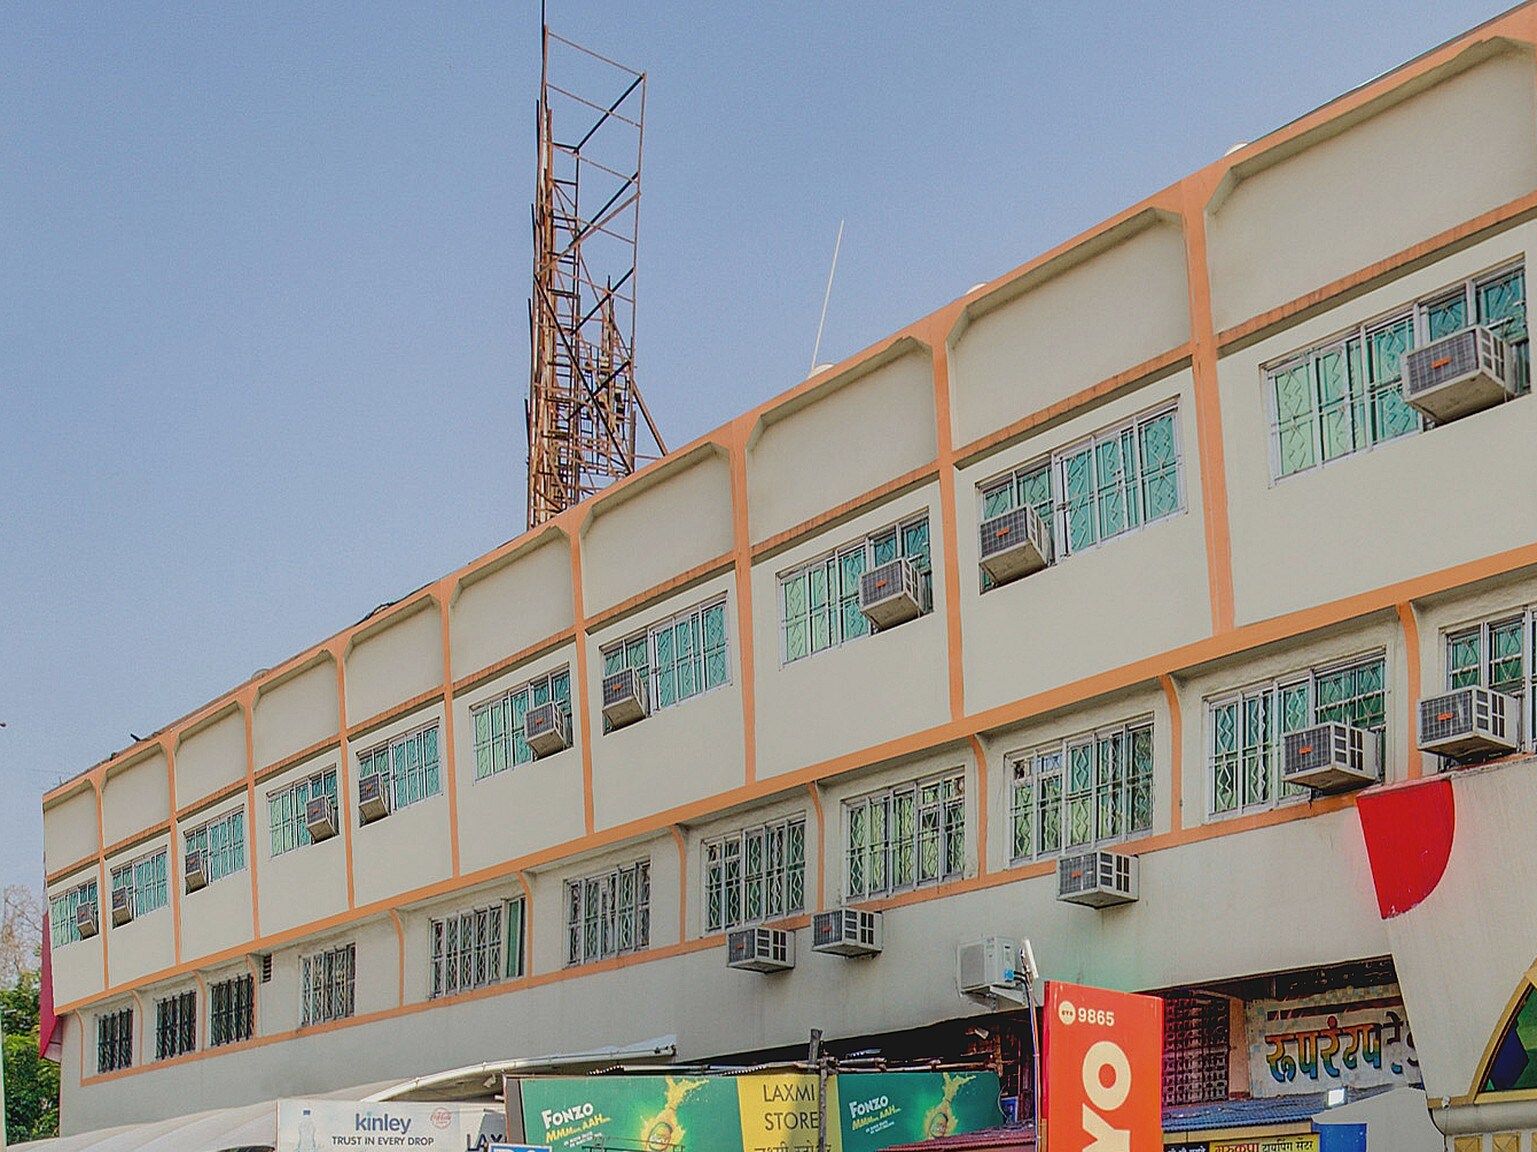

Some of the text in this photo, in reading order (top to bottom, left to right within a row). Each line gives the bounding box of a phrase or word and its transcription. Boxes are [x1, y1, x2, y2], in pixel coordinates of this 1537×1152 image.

[1078, 1007, 1115, 1026] 9865
[763, 1084, 816, 1102] LAXMI
[541, 1103, 594, 1130] FONZO
[849, 1095, 888, 1119] FONZO
[355, 1112, 411, 1135] kinley
[765, 1112, 819, 1131] STORE
[332, 1136, 434, 1147] TRUST IN EVERY DROP
